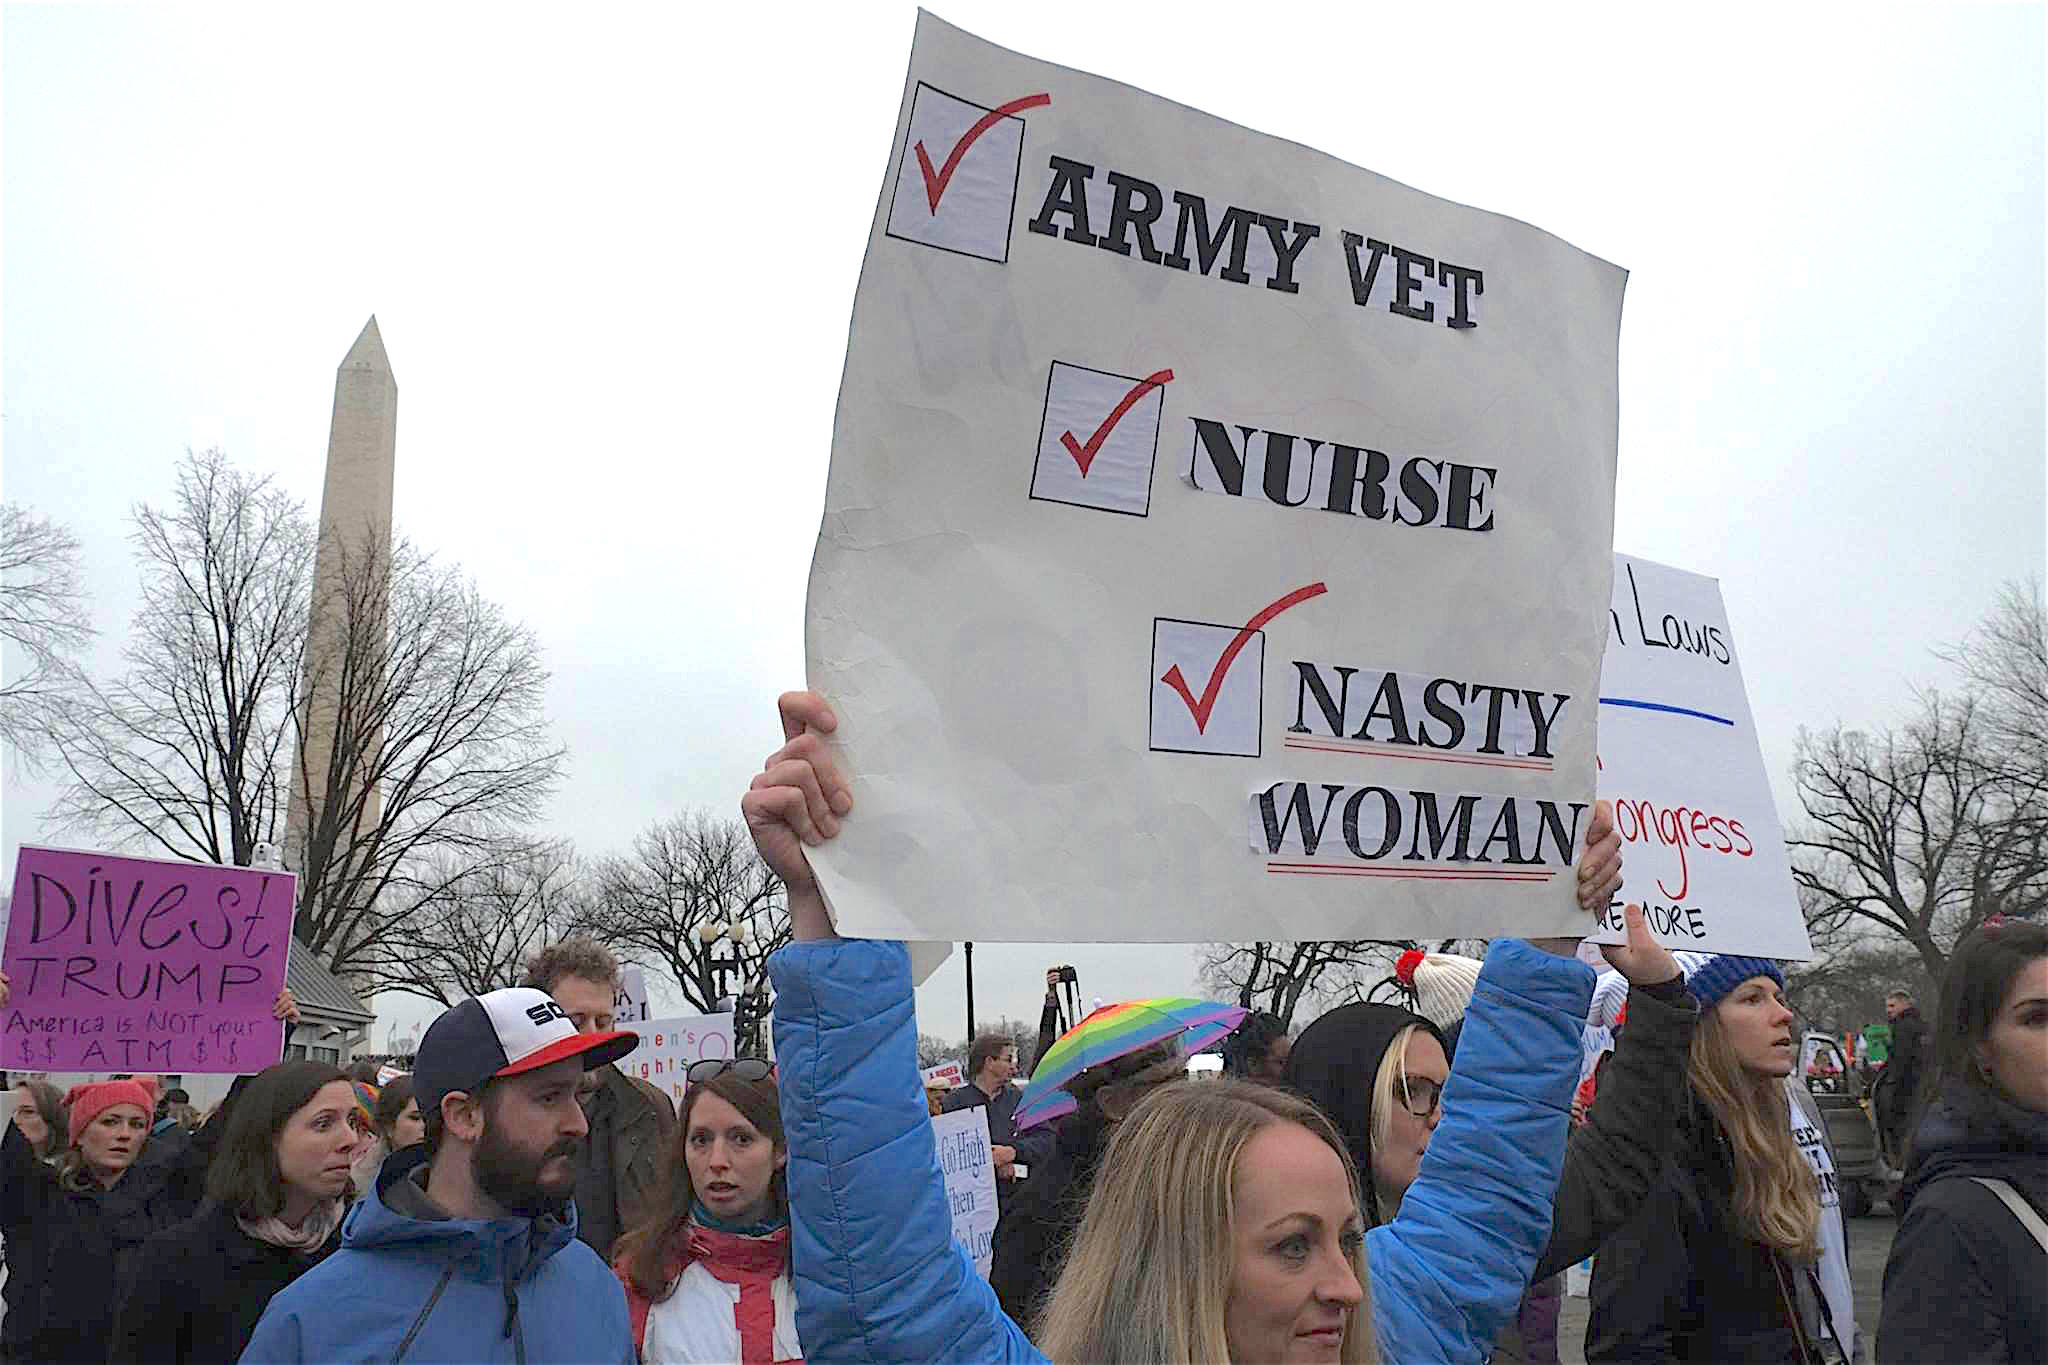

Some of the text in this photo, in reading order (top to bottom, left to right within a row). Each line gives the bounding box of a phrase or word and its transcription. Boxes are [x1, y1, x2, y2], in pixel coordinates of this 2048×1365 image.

[1028, 155, 1485, 330] ARMY VET
[1188, 417, 1498, 532] NURSE
[1626, 562, 1731, 665] Laws
[1287, 661, 1570, 759] NASTY
[1259, 781, 1589, 866] WOMAN
[1615, 799, 1753, 901] ongress
[31, 866, 270, 959] Divest
[16, 956, 262, 1003] TRUMP
[6, 1009, 262, 1048] America is NOT your
[80, 1038, 171, 1067] ATM
[640, 1028, 697, 1049] men's
[942, 1127, 987, 1178] Go High
[949, 1186, 976, 1216] hen
